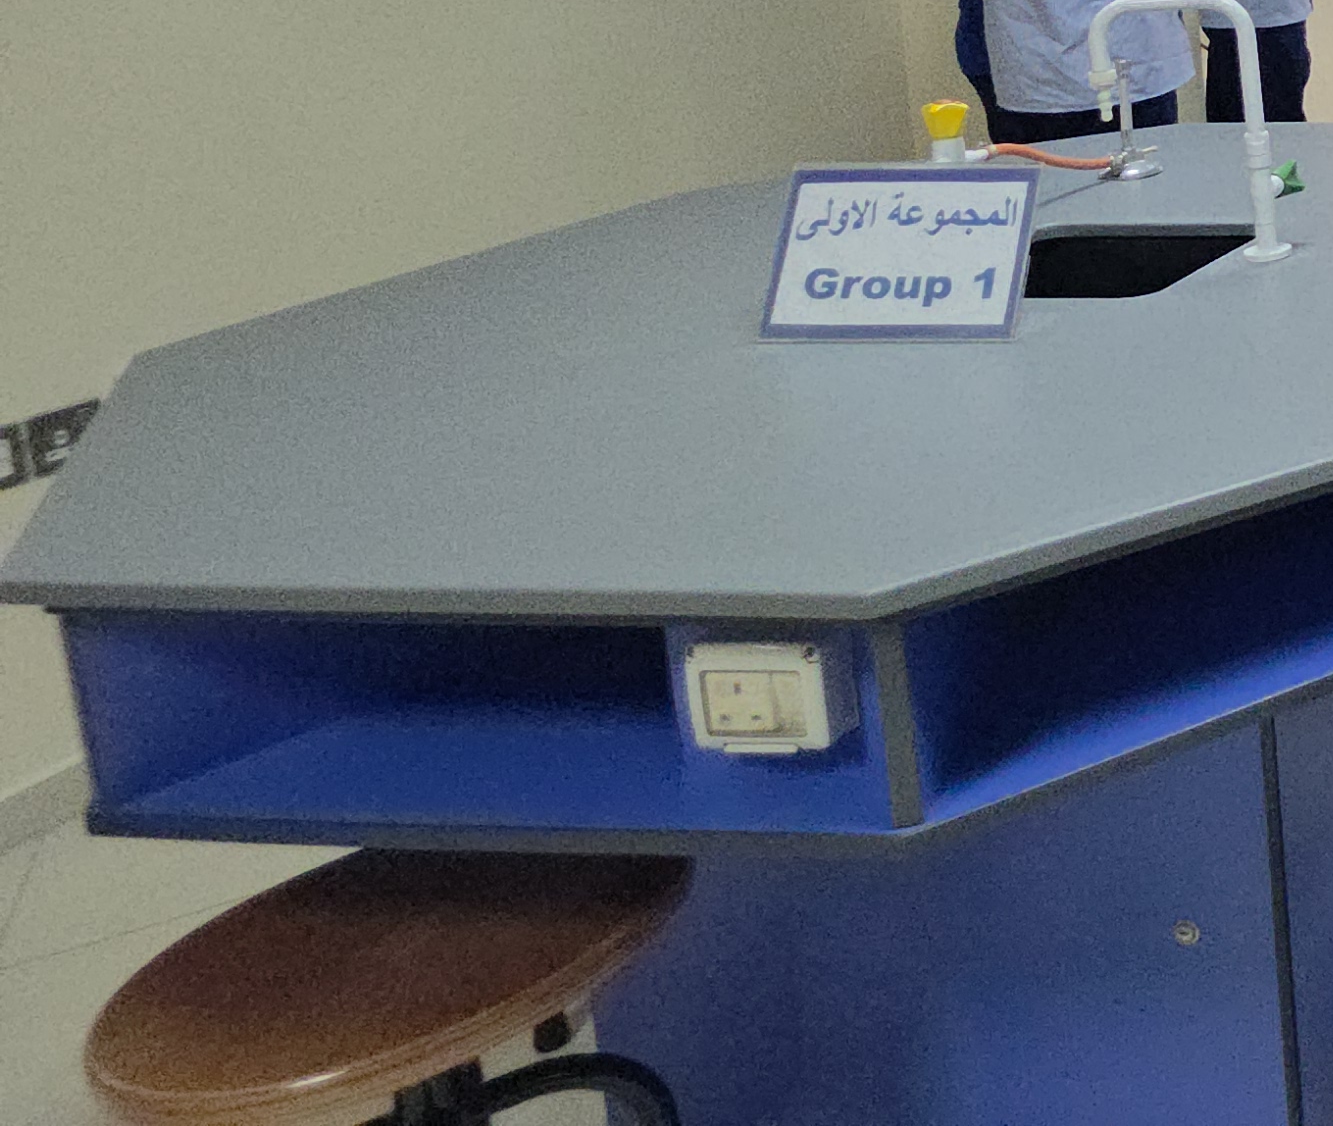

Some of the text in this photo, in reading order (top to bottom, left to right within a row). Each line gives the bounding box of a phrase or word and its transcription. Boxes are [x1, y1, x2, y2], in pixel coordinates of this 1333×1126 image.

[887, 191, 1019, 236] المجموعة
[804, 266, 997, 307] Group 1
